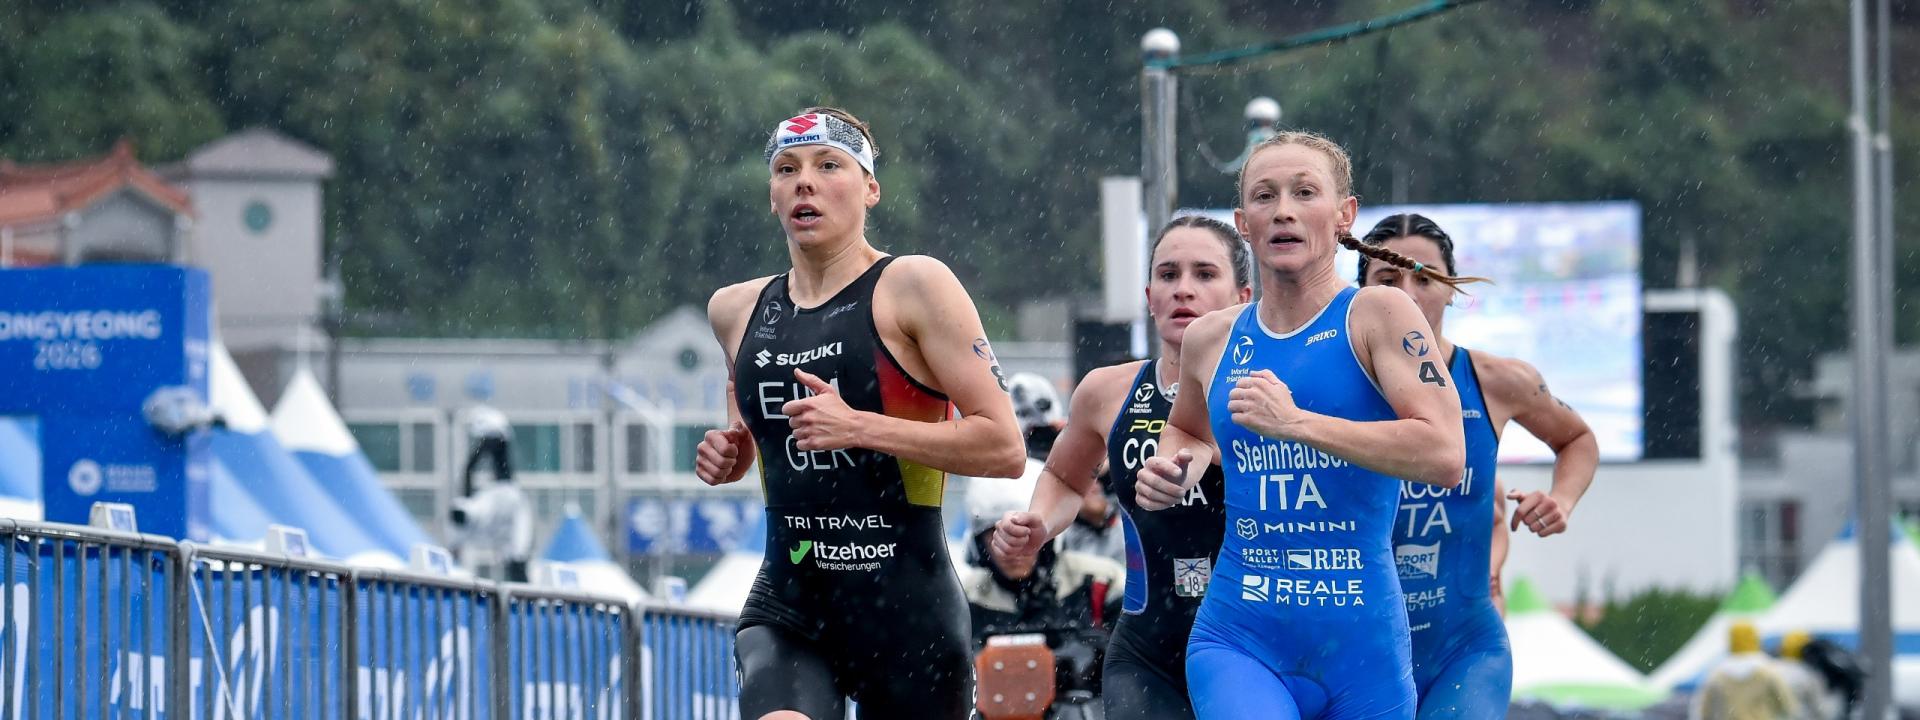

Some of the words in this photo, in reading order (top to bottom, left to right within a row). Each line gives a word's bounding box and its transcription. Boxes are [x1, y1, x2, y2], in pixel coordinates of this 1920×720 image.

[784, 135, 820, 145] SUZUKI
[754, 331, 777, 340] Triathlon
[759, 325, 776, 334] World
[1305, 328, 1338, 346] BRIKO
[775, 341, 843, 366] SUZUKI
[1419, 361, 1446, 387] 4
[785, 434, 856, 471] GER
[1259, 473, 1328, 511] ITA
[784, 515, 811, 530] TRI
[815, 514, 892, 531] TRAVEL
[1264, 520, 1356, 534] MININI
[813, 541, 897, 560] Itzehoer
[1242, 548, 1278, 556] SPORT
[816, 560, 881, 572] Versicherungen
[1189, 576, 1200, 592] 18
[1276, 578, 1364, 595] REALE
[1276, 594, 1364, 607] MUTUA
